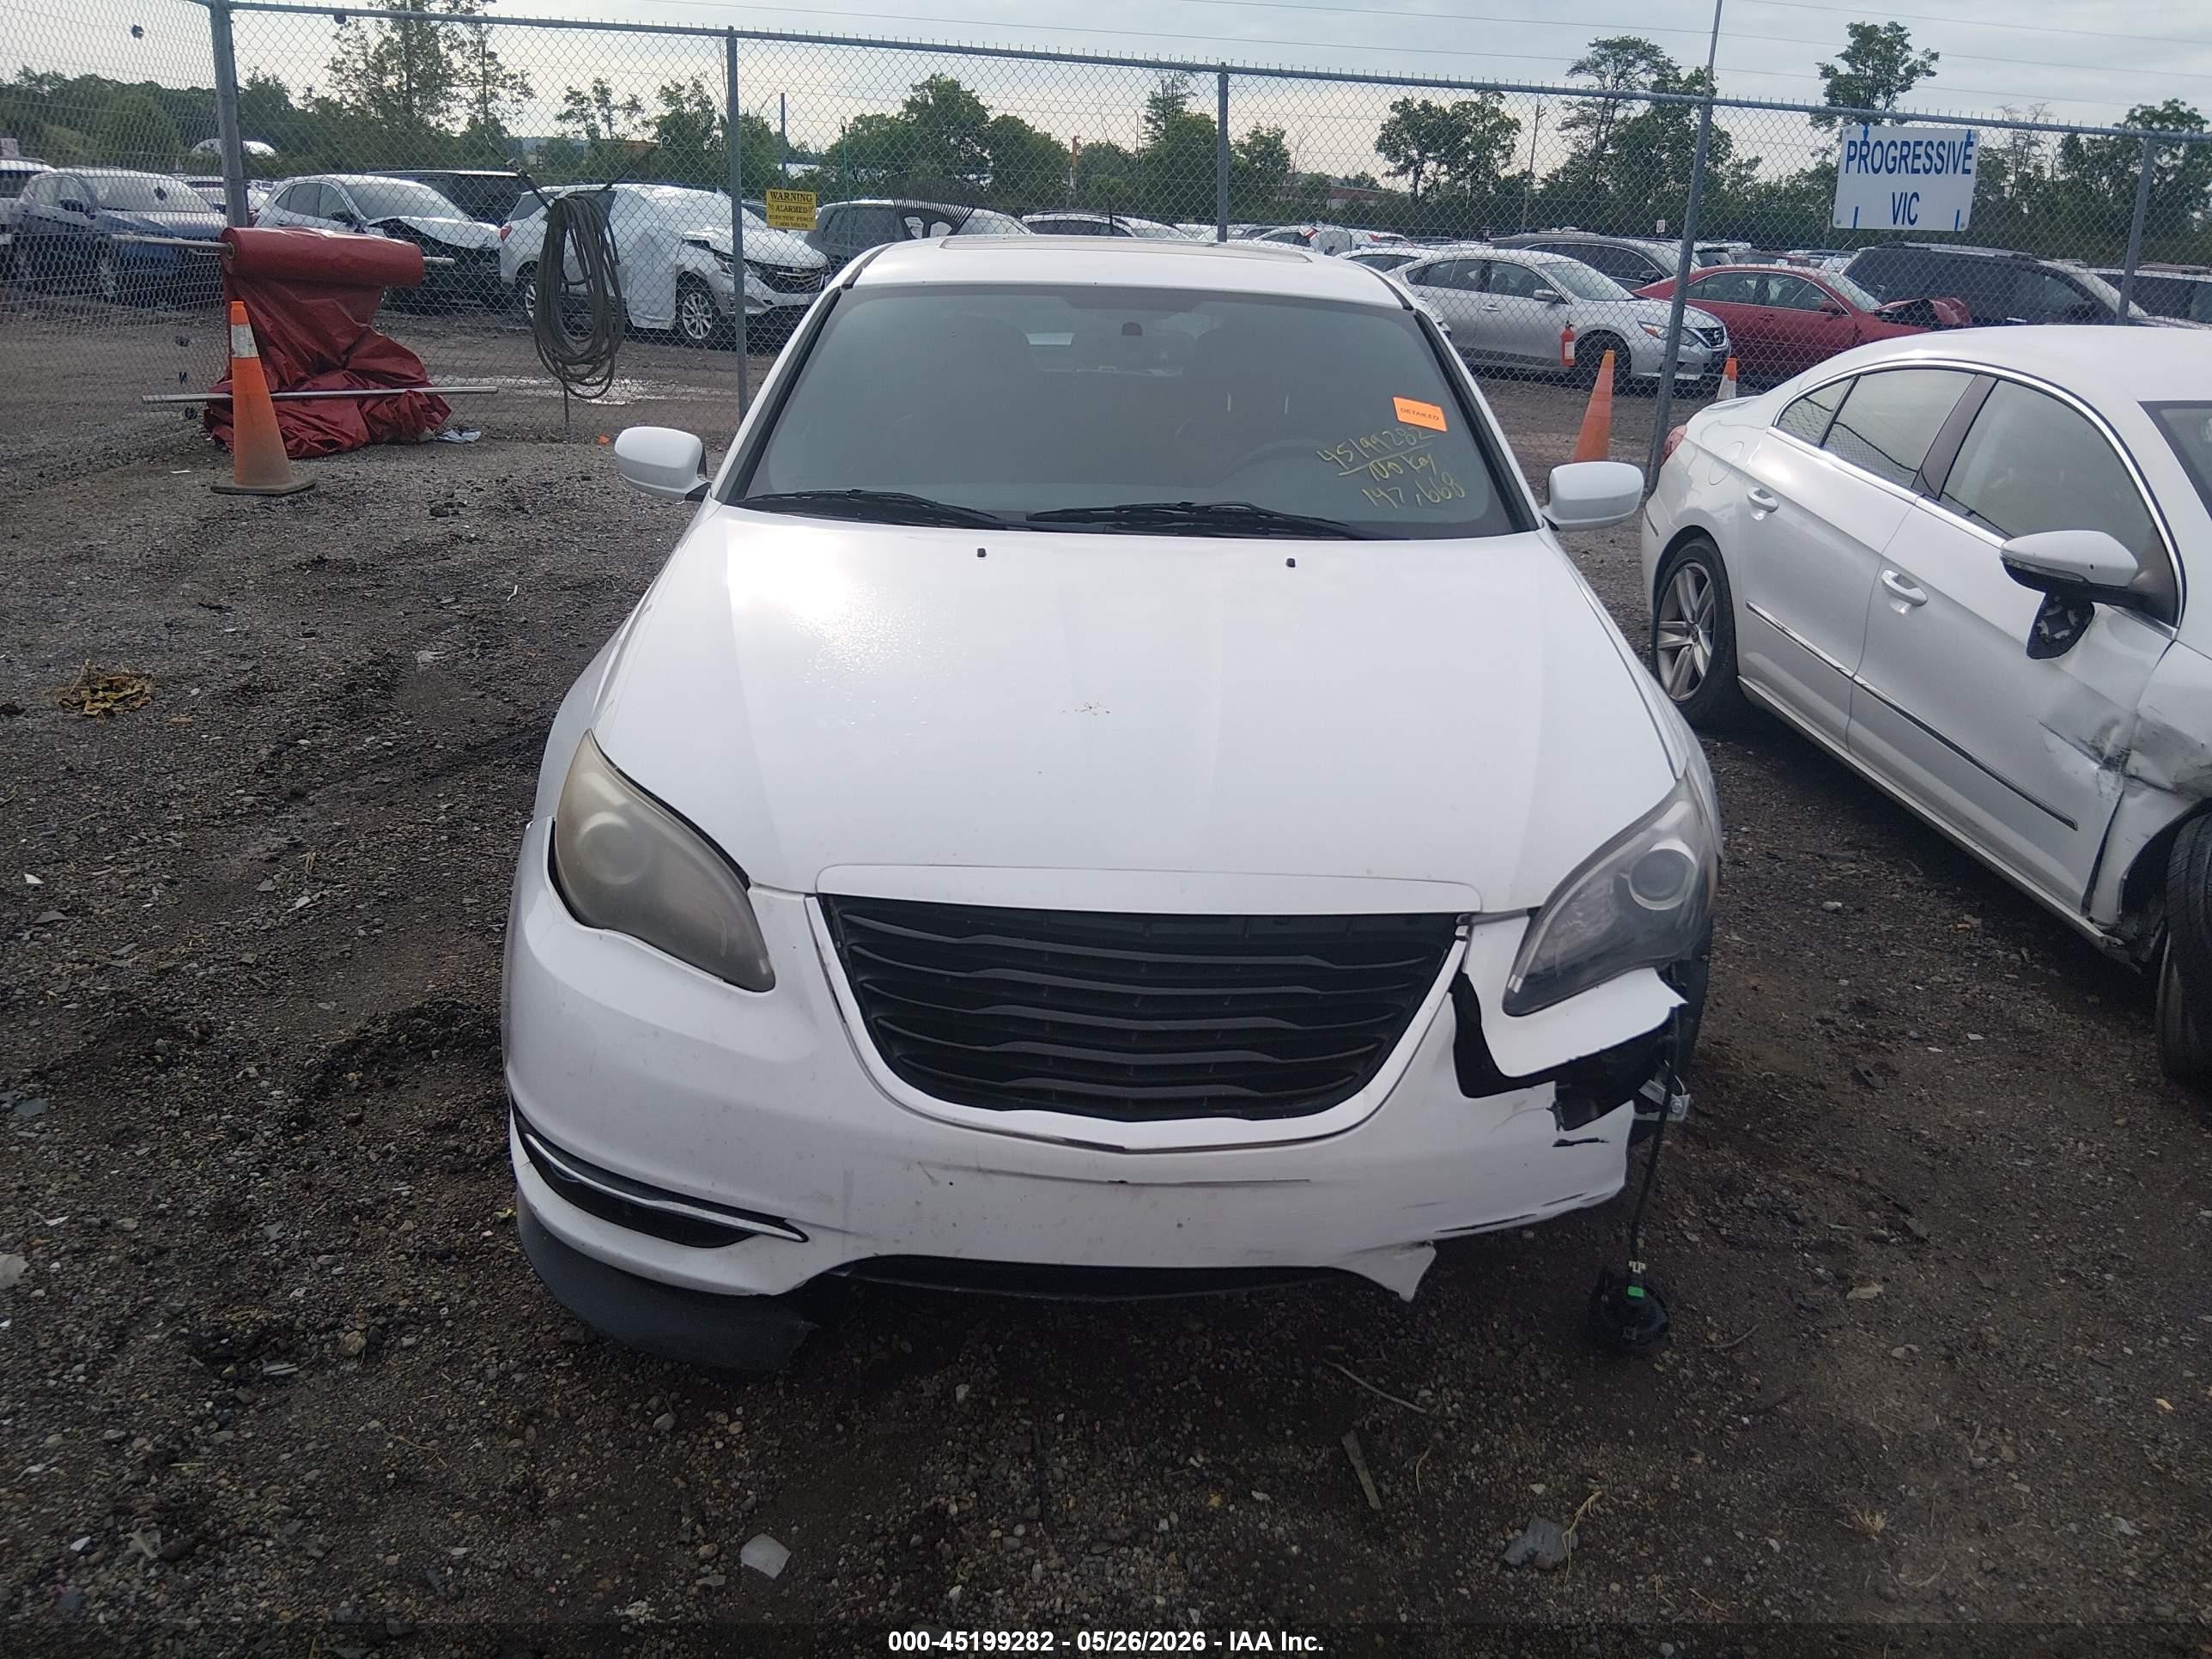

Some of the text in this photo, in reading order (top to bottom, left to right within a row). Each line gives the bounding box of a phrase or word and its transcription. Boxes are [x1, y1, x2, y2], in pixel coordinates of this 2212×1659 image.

[1845, 140, 1974, 175] PROGRESSIVE
[769, 191, 813, 203] WARNING
[1892, 191, 1920, 226] VIC
[775, 205, 808, 214] ALARMED
[1400, 407, 1440, 421] DETAILED
[1316, 426, 1437, 470] 45199282
